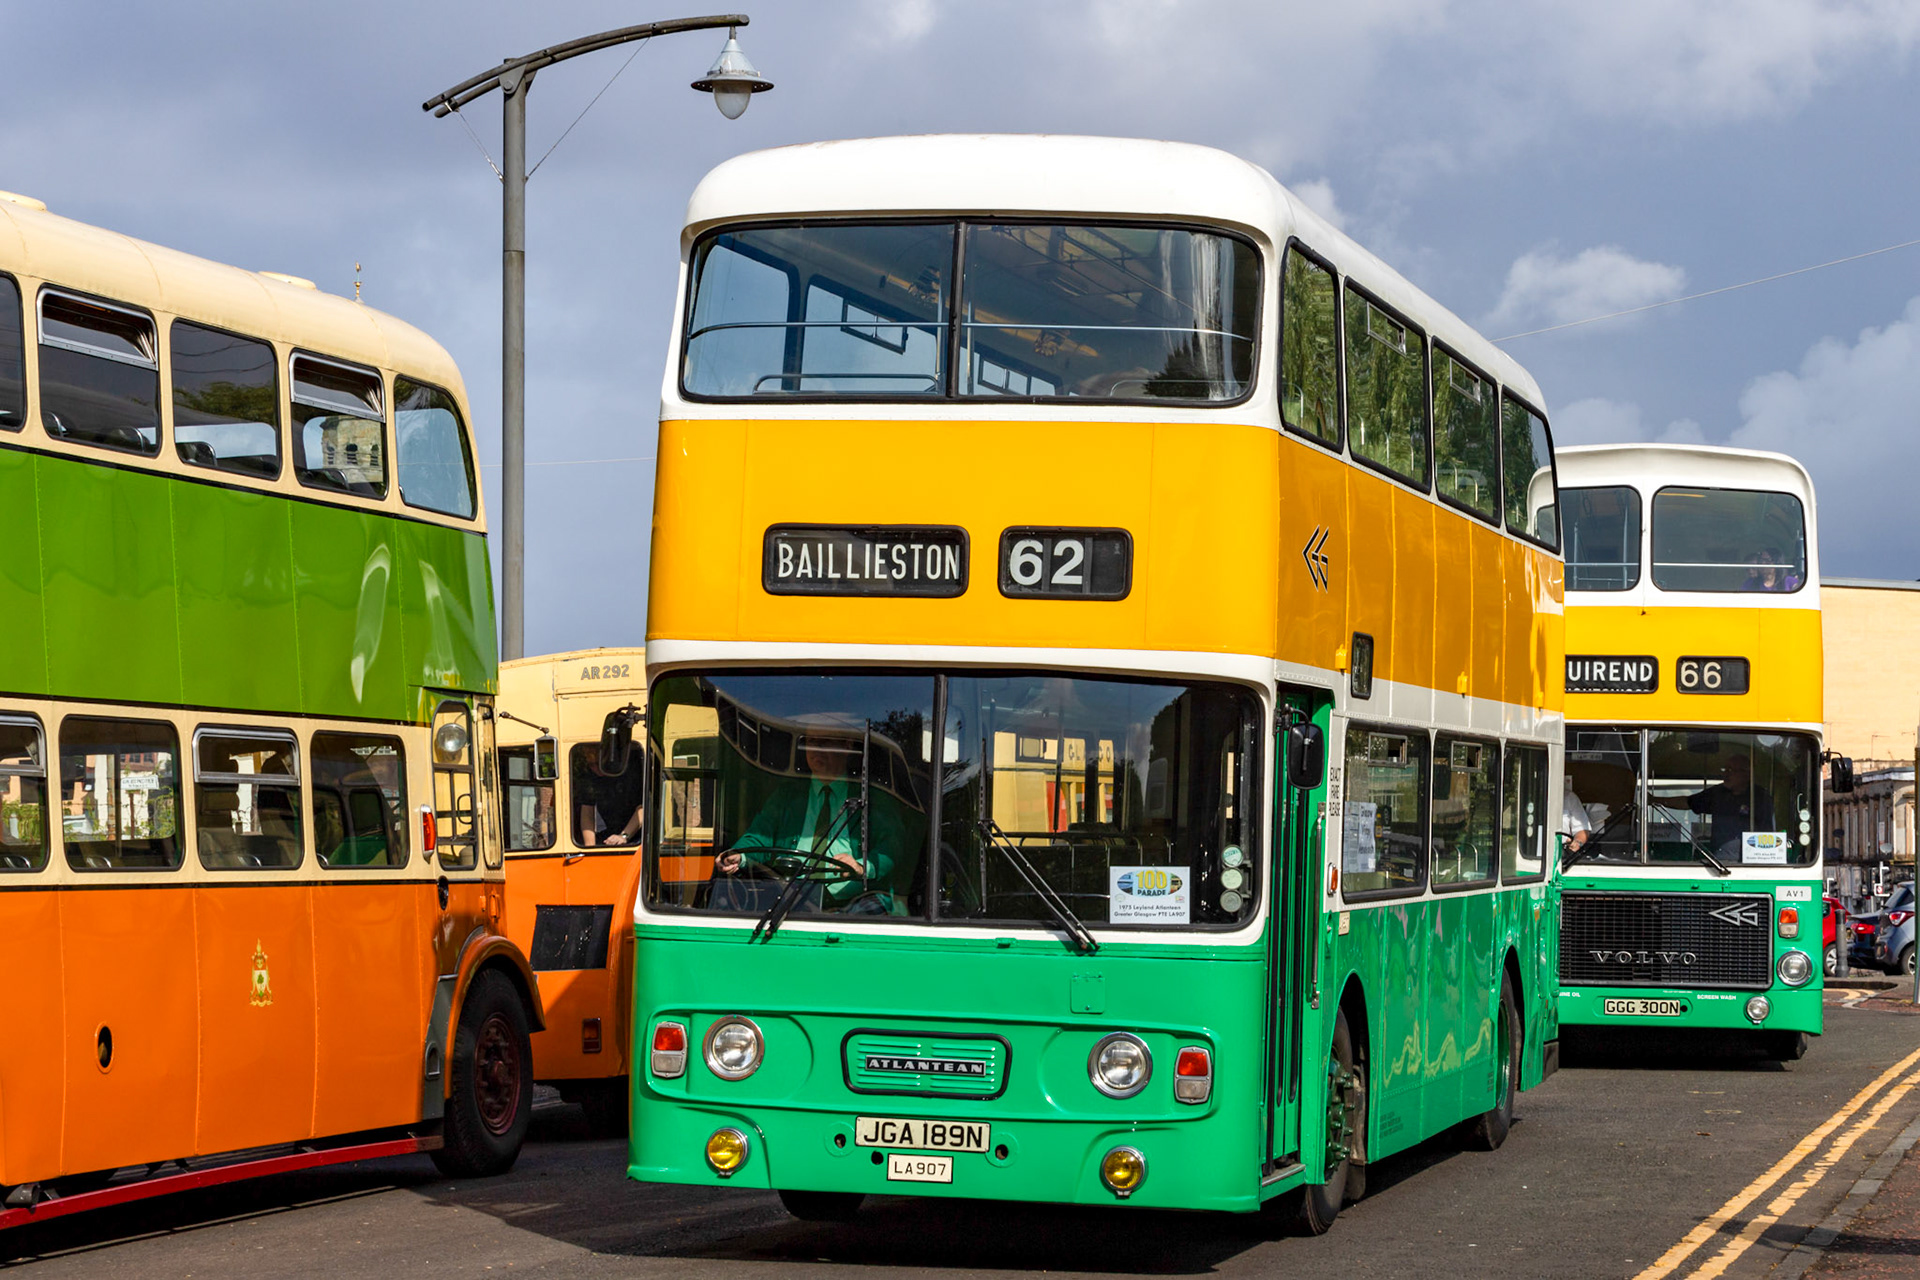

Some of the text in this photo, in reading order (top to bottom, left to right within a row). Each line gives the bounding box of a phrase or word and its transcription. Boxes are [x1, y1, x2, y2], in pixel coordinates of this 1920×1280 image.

[777, 543, 960, 580] BAILLIESTON
[1009, 539, 1084, 586] 62
[1567, 660, 1653, 682] UIREND
[1680, 661, 1722, 689] 66
[1757, 834, 1774, 845] 100
[1136, 870, 1168, 890] 100
[1137, 889, 1167, 897] PARADE
[1133, 904, 1154, 912] Leyland
[1589, 950, 1697, 965] VOLVO
[1606, 1001, 1680, 1014] GGG 300N
[868, 1058, 983, 1073] ATLANTEAN
[863, 1121, 983, 1148] JGA 189N
[894, 1161, 946, 1177] LA907
